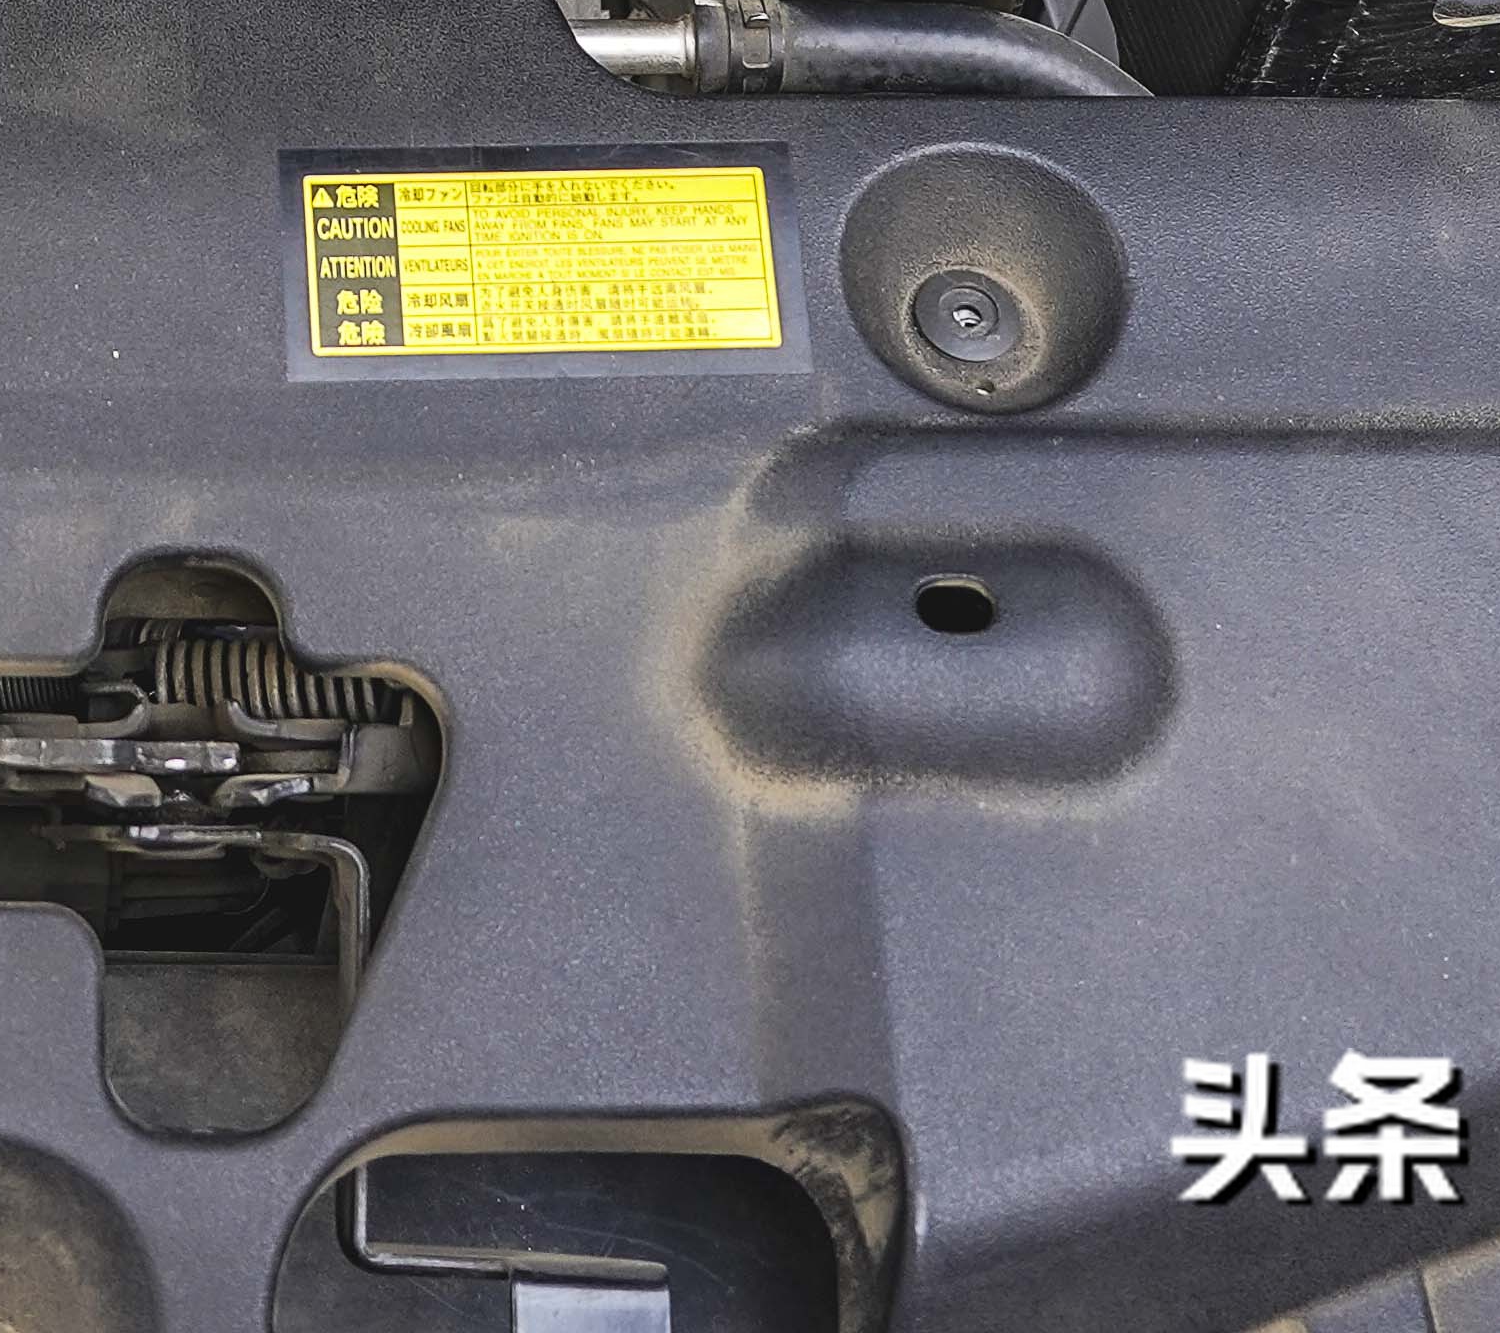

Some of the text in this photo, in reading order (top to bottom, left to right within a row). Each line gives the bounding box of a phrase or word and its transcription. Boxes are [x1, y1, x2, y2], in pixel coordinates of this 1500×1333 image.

[399, 187, 462, 205] 冷却ファン
[472, 209, 489, 219] TO
[496, 209, 530, 219] AVOID
[537, 208, 598, 218] PERSONAL
[656, 205, 686, 215] KEEP
[694, 204, 734, 214] HANDS
[316, 216, 395, 240] CAUTION
[401, 219, 465, 233] COOLING FANS
[475, 220, 505, 230] AWAY
[513, 220, 546, 230] FROM
[593, 218, 624, 229] FANS
[630, 218, 654, 228] MAY
[661, 217, 697, 227] START
[704, 216, 717, 226] AT
[725, 215, 748, 226] ANY
[320, 255, 397, 279] ATTENTION
[404, 258, 469, 273] VENTILATEURS
[407, 292, 469, 309] 冷却风扇
